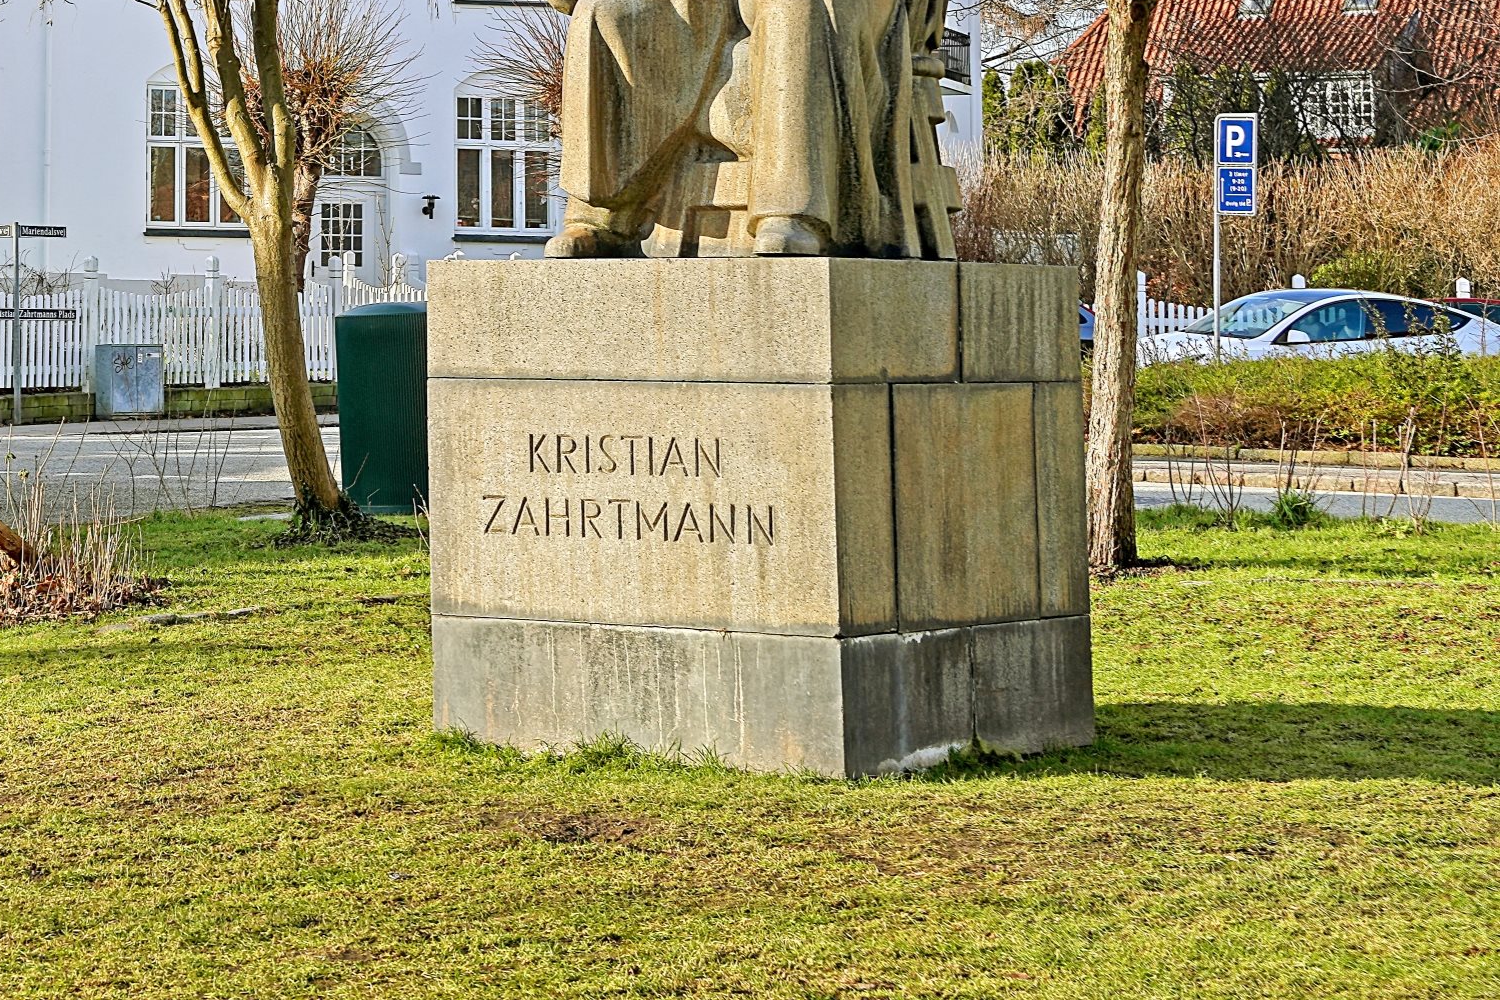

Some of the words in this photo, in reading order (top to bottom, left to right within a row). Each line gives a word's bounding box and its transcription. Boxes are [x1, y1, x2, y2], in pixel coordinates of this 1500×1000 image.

[1226, 125, 1245, 158] P
[21, 226, 66, 236] Mariendalsvej
[19, 309, 57, 319] Zahrtmanns
[58, 310, 75, 319] Plads
[528, 433, 722, 478] KRISTIAN
[482, 494, 776, 546] ZAHRTMANN
